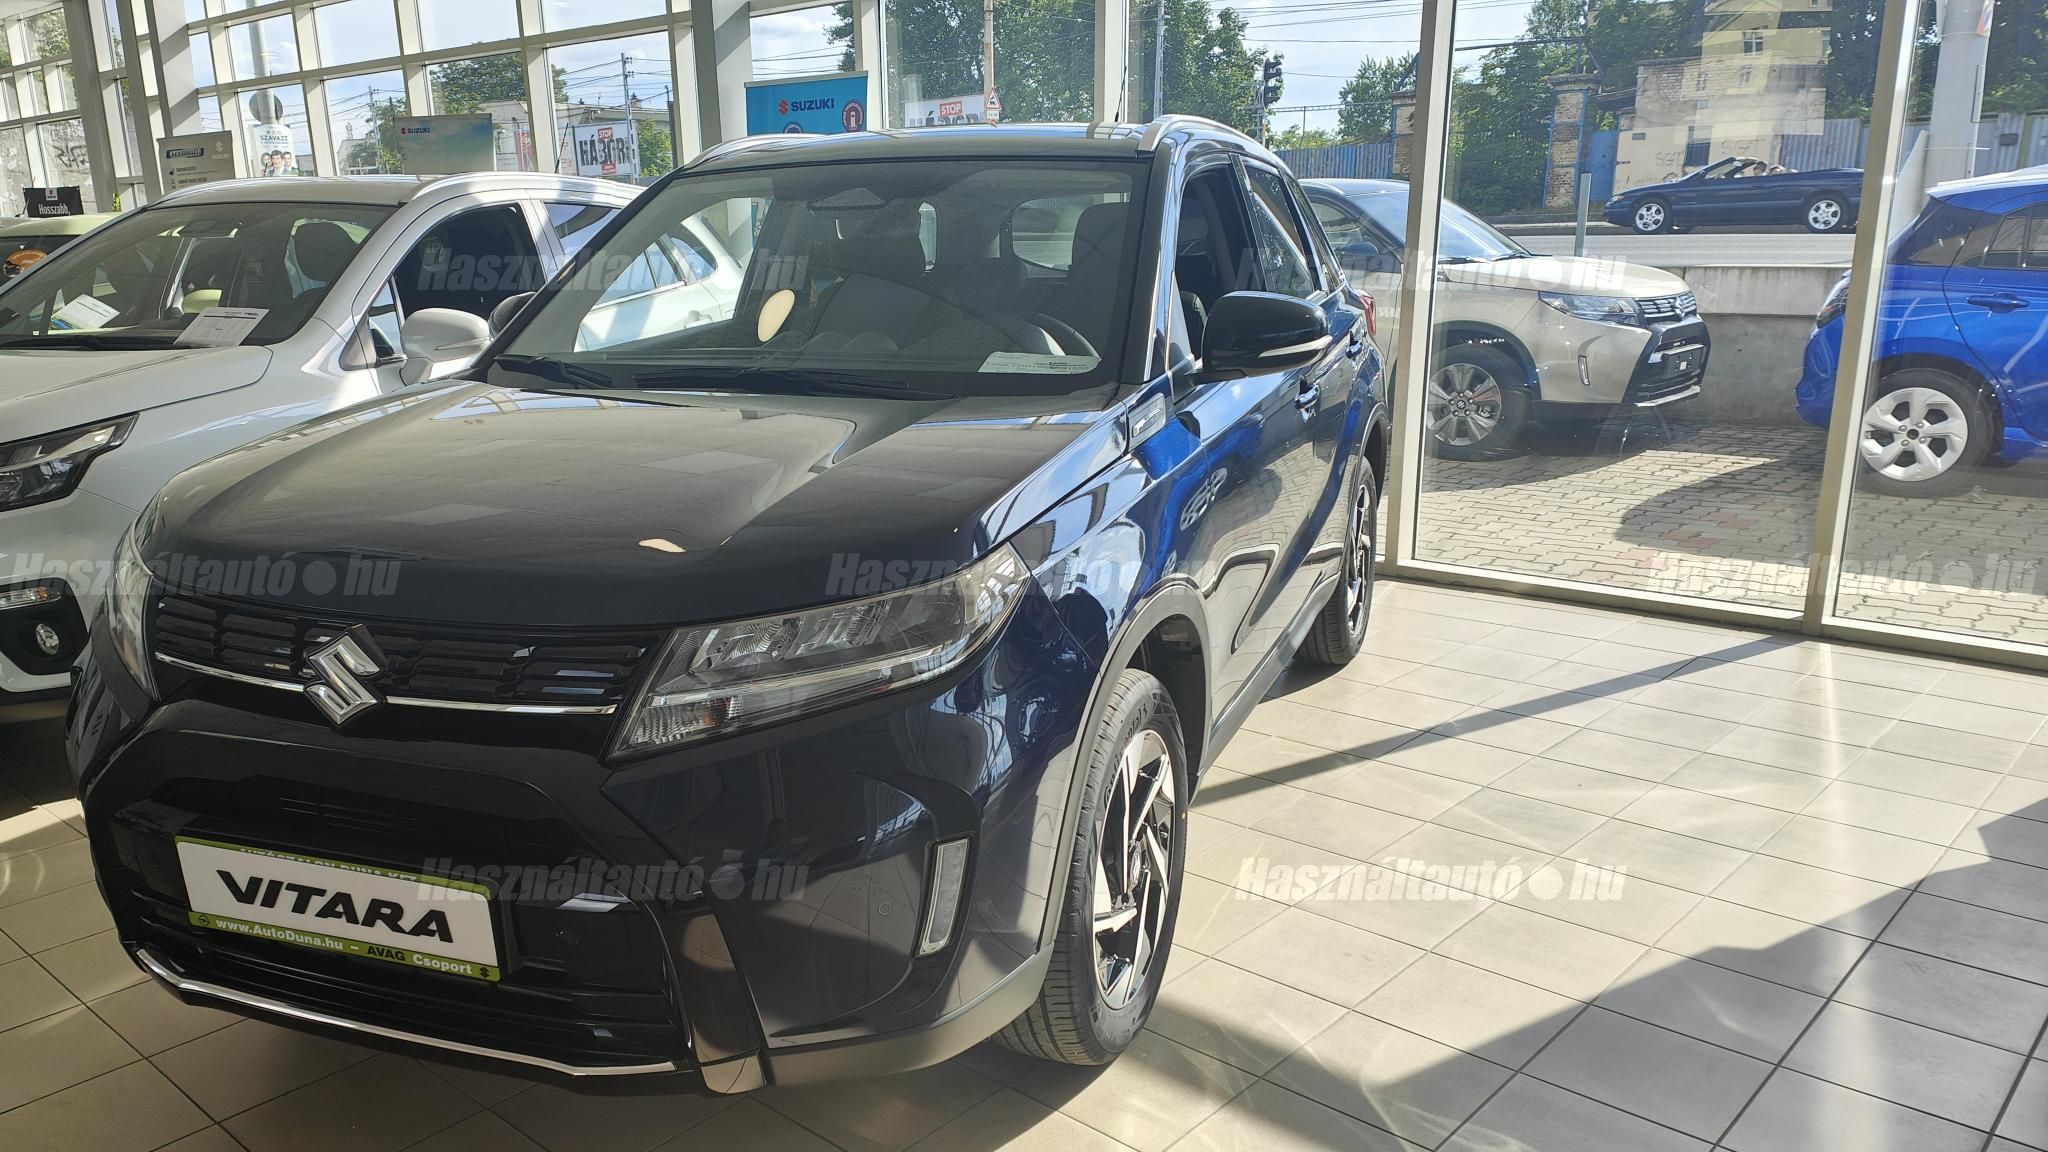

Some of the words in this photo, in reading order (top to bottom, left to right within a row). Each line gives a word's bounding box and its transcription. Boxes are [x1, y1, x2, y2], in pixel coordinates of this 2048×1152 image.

[791, 98, 835, 112] SUZUKI
[941, 103, 961, 115] STOP
[599, 129, 613, 138] STOP
[38, 203, 71, 216] Hosszabb,
[216, 869, 453, 943] VITARA
[216, 919, 343, 950] www.AutoDuna.hu
[367, 945, 405, 961] AVAG
[413, 953, 473, 974] Csoport
